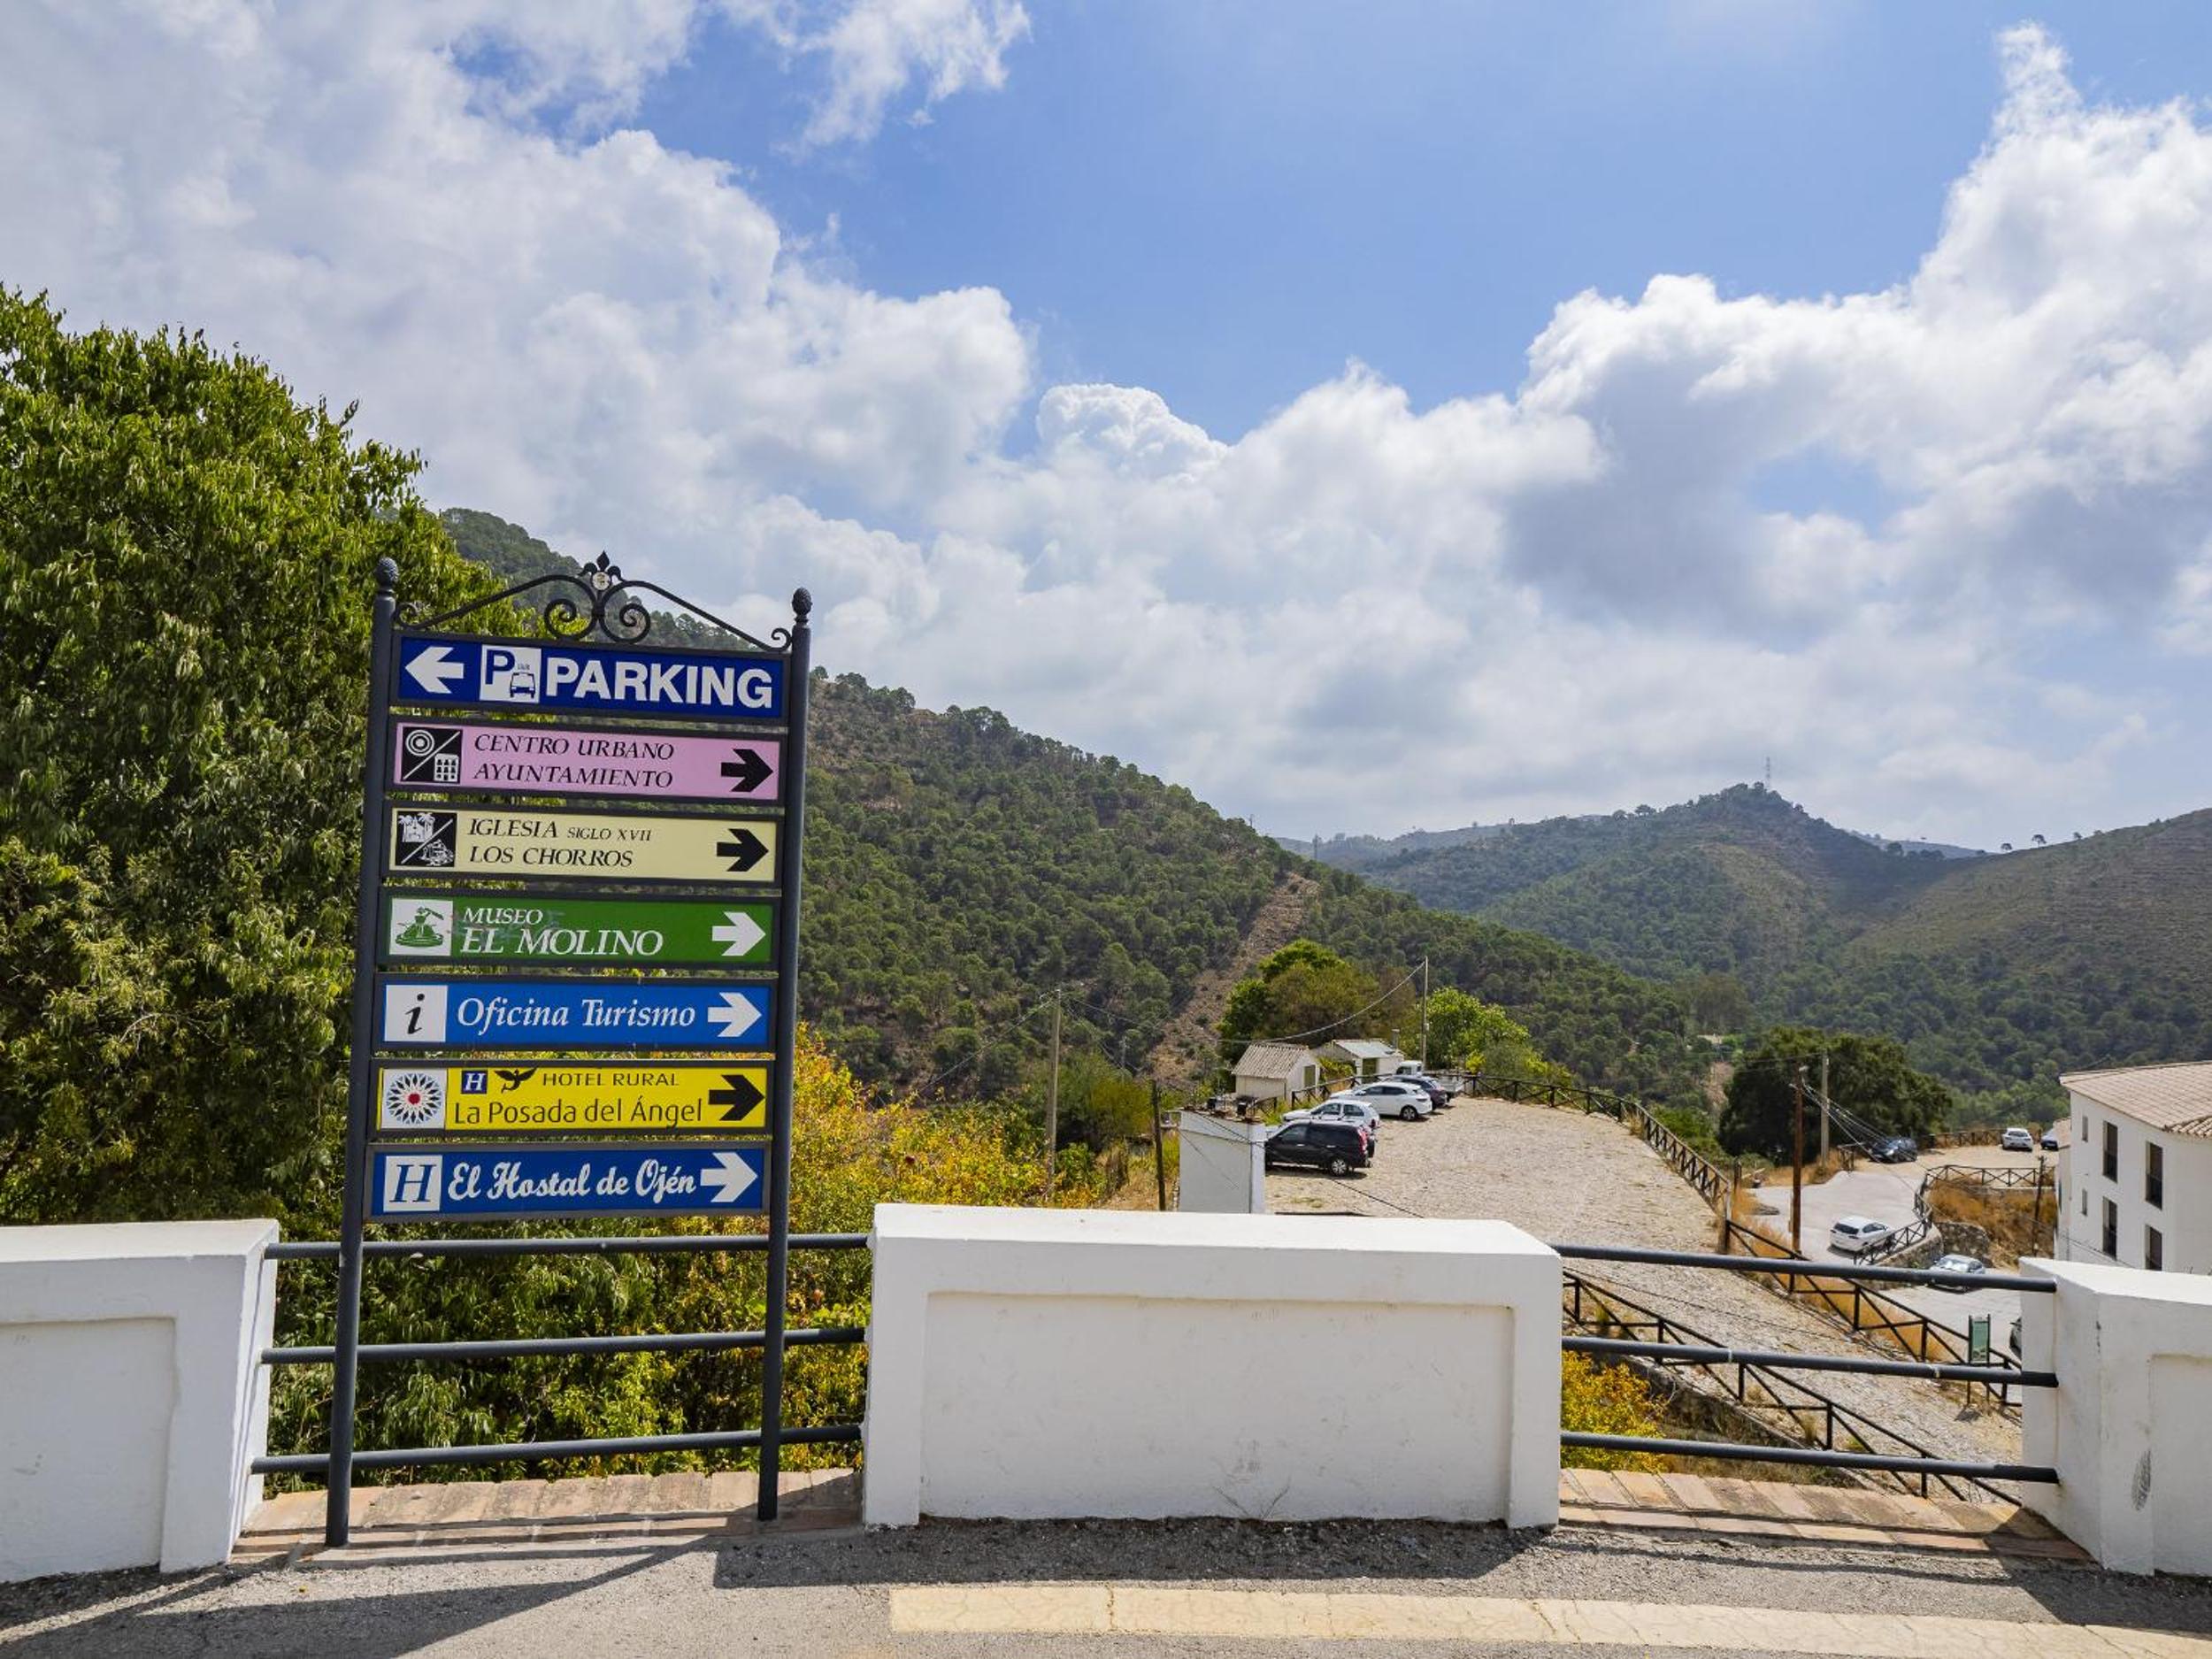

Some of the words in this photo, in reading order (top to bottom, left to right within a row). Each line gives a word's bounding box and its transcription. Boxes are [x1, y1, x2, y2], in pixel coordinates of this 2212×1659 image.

[486, 650, 515, 685] P
[545, 657, 772, 709] PARKING
[473, 733, 570, 755] CENTRO
[577, 739, 675, 760] URBANO
[473, 764, 673, 788] AYUNTAMIENTO
[468, 818, 558, 839] IGLESIA
[566, 826, 611, 841] SIGLO
[617, 828, 652, 841] XVII
[469, 845, 514, 864] LOS
[522, 847, 634, 867] CHORROS
[463, 908, 543, 925] MUSEO
[459, 929, 504, 954] EL
[517, 929, 664, 956] MOLINO
[404, 993, 426, 1034] i
[457, 997, 570, 1035] Oficina
[580, 998, 696, 1028] Turismo
[464, 1071, 488, 1091] H
[542, 1072, 606, 1087] HOTEL
[613, 1072, 680, 1087] RURAL
[454, 1102, 480, 1125] La
[488, 1100, 577, 1123] Posada
[584, 1099, 623, 1122] del
[630, 1096, 703, 1129] Ángel
[390, 1164, 438, 1203] H
[448, 1162, 480, 1201] El
[487, 1163, 592, 1201] Hostal
[596, 1167, 630, 1197] de
[635, 1158, 696, 1204] Ojén
